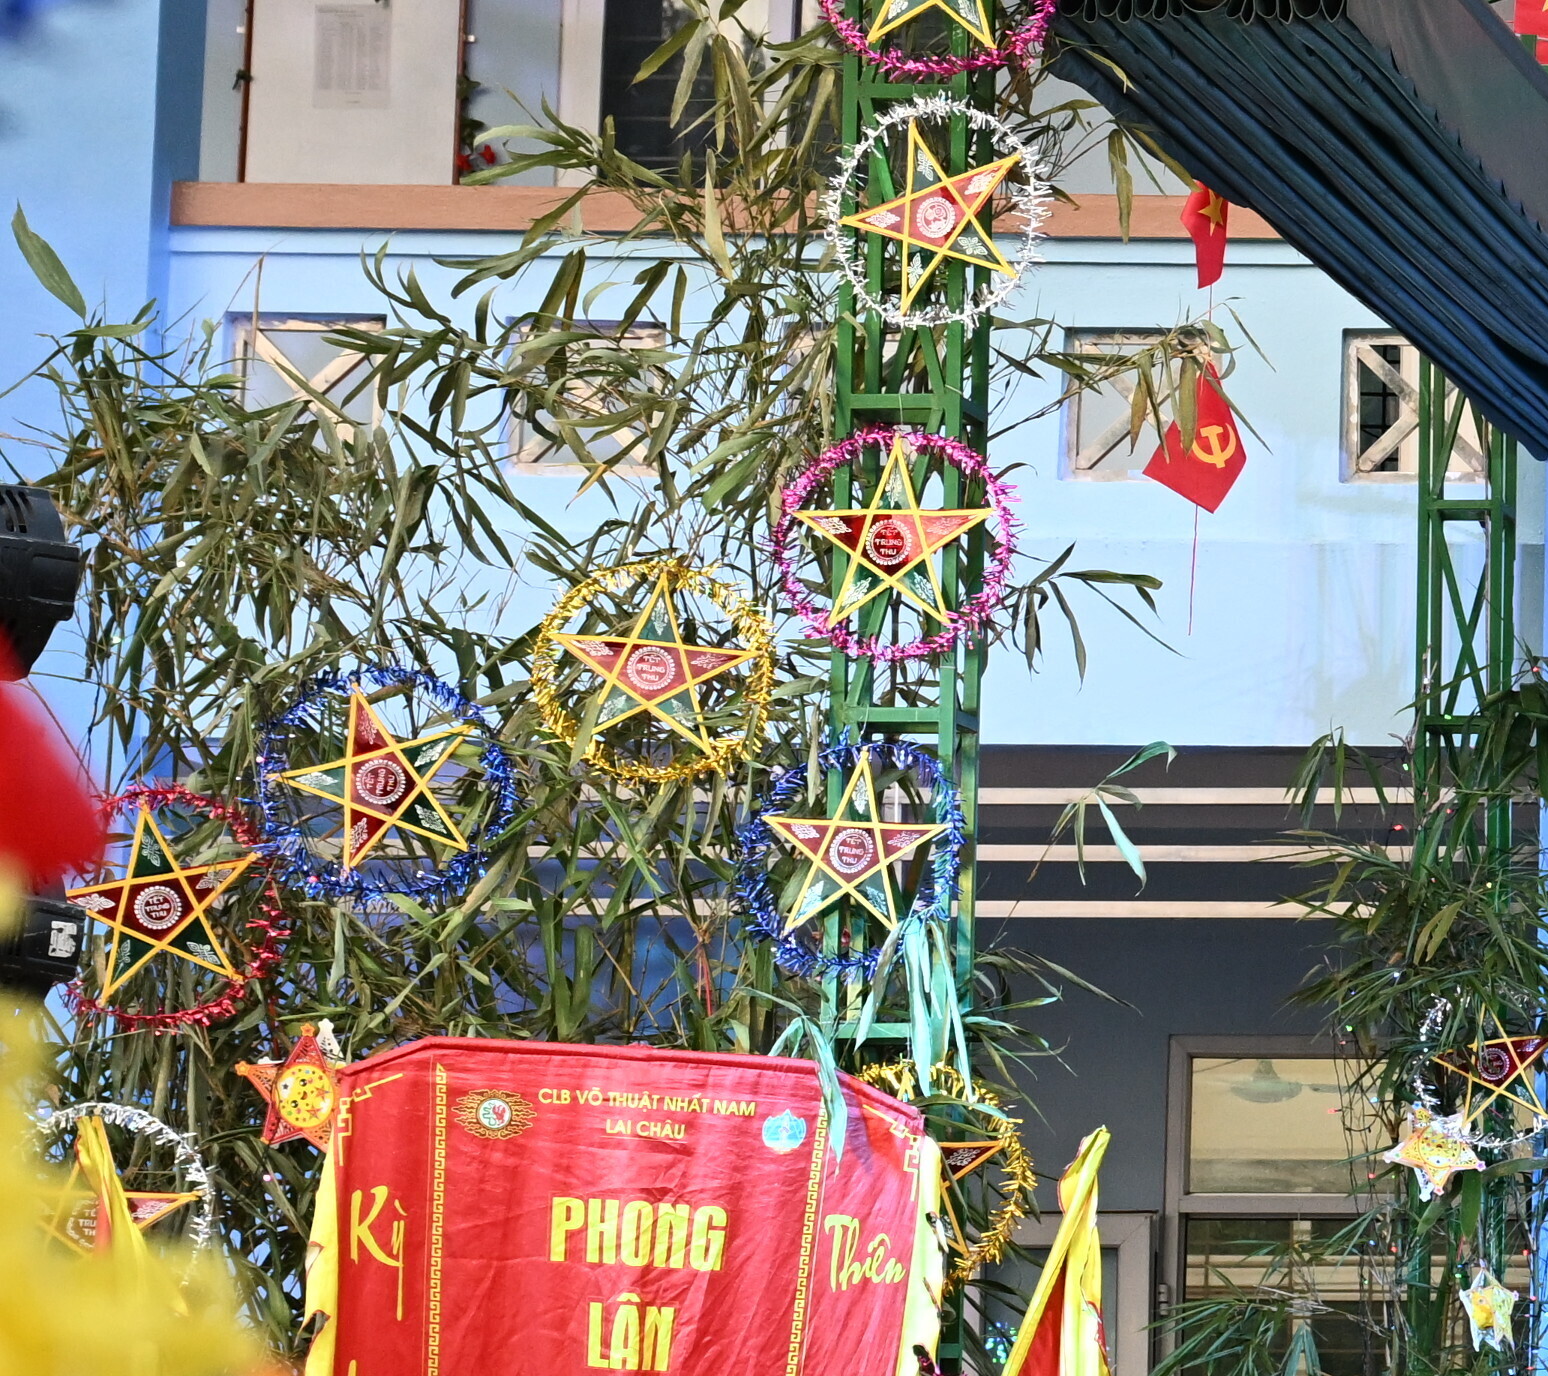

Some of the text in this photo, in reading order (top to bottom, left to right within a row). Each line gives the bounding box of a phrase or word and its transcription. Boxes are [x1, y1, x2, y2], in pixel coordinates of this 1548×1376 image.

[538, 1089, 571, 1103] CLB
[576, 1087, 603, 1105] VÕ
[607, 1091, 660, 1112] THUẬT
[713, 1100, 756, 1116] NAM
[606, 1119, 686, 1139] LAI CHÂU
[550, 1197, 727, 1271] PHONG
[823, 1213, 906, 1292] Thiên
[587, 1292, 676, 1372] LÂN
